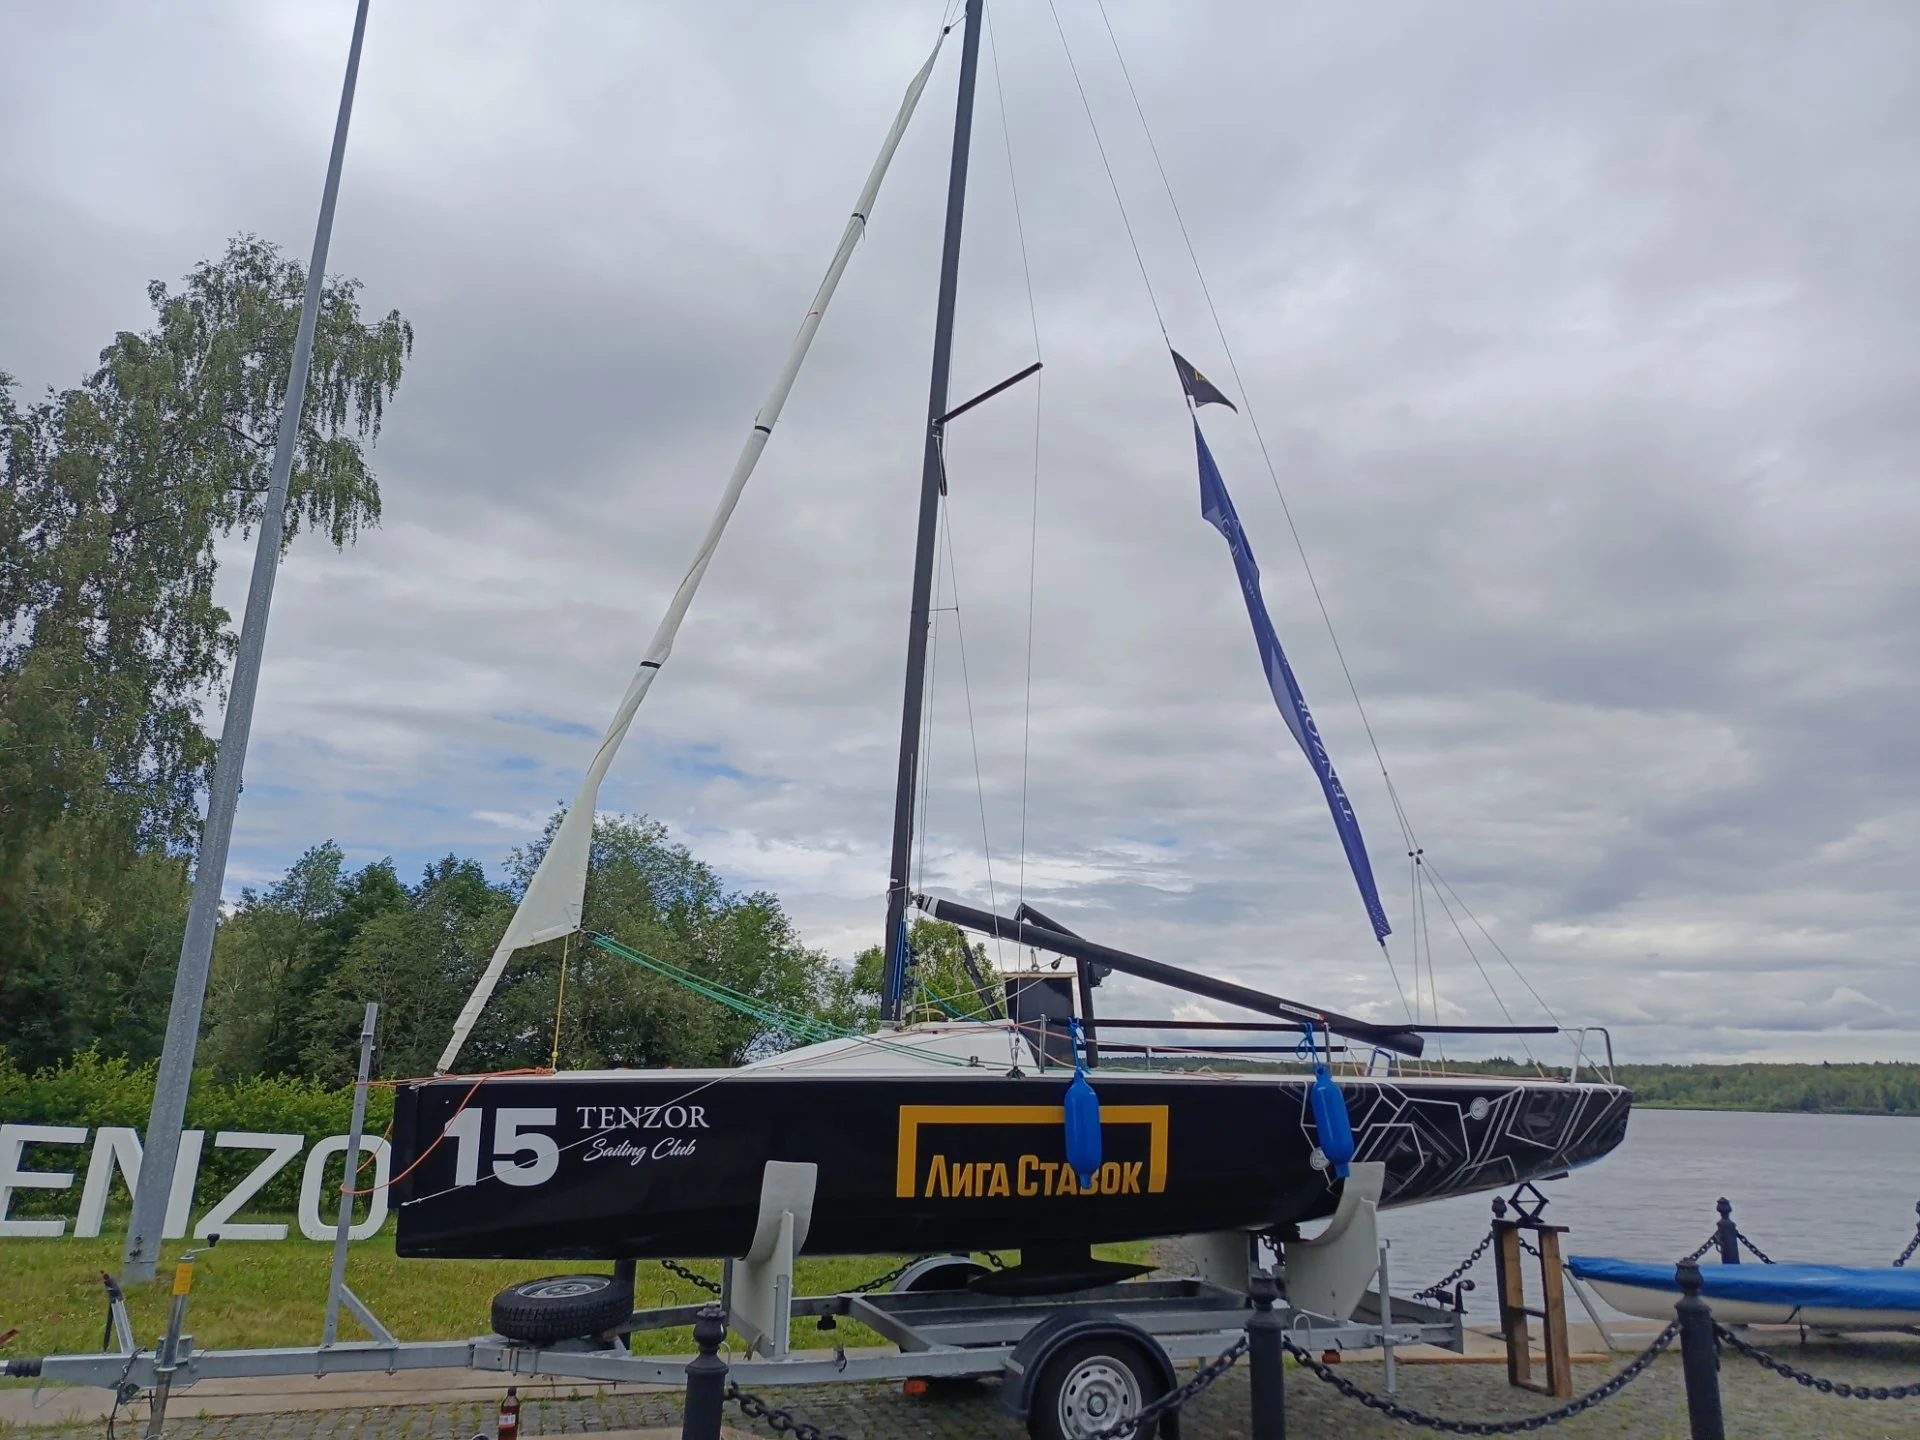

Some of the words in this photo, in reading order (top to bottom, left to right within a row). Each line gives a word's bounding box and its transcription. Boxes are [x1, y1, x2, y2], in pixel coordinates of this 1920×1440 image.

[576, 1105, 711, 1129] TENZOR
[444, 1107, 560, 1187] 15
[583, 1138, 648, 1166] Sailing
[651, 1137, 697, 1160] Club
